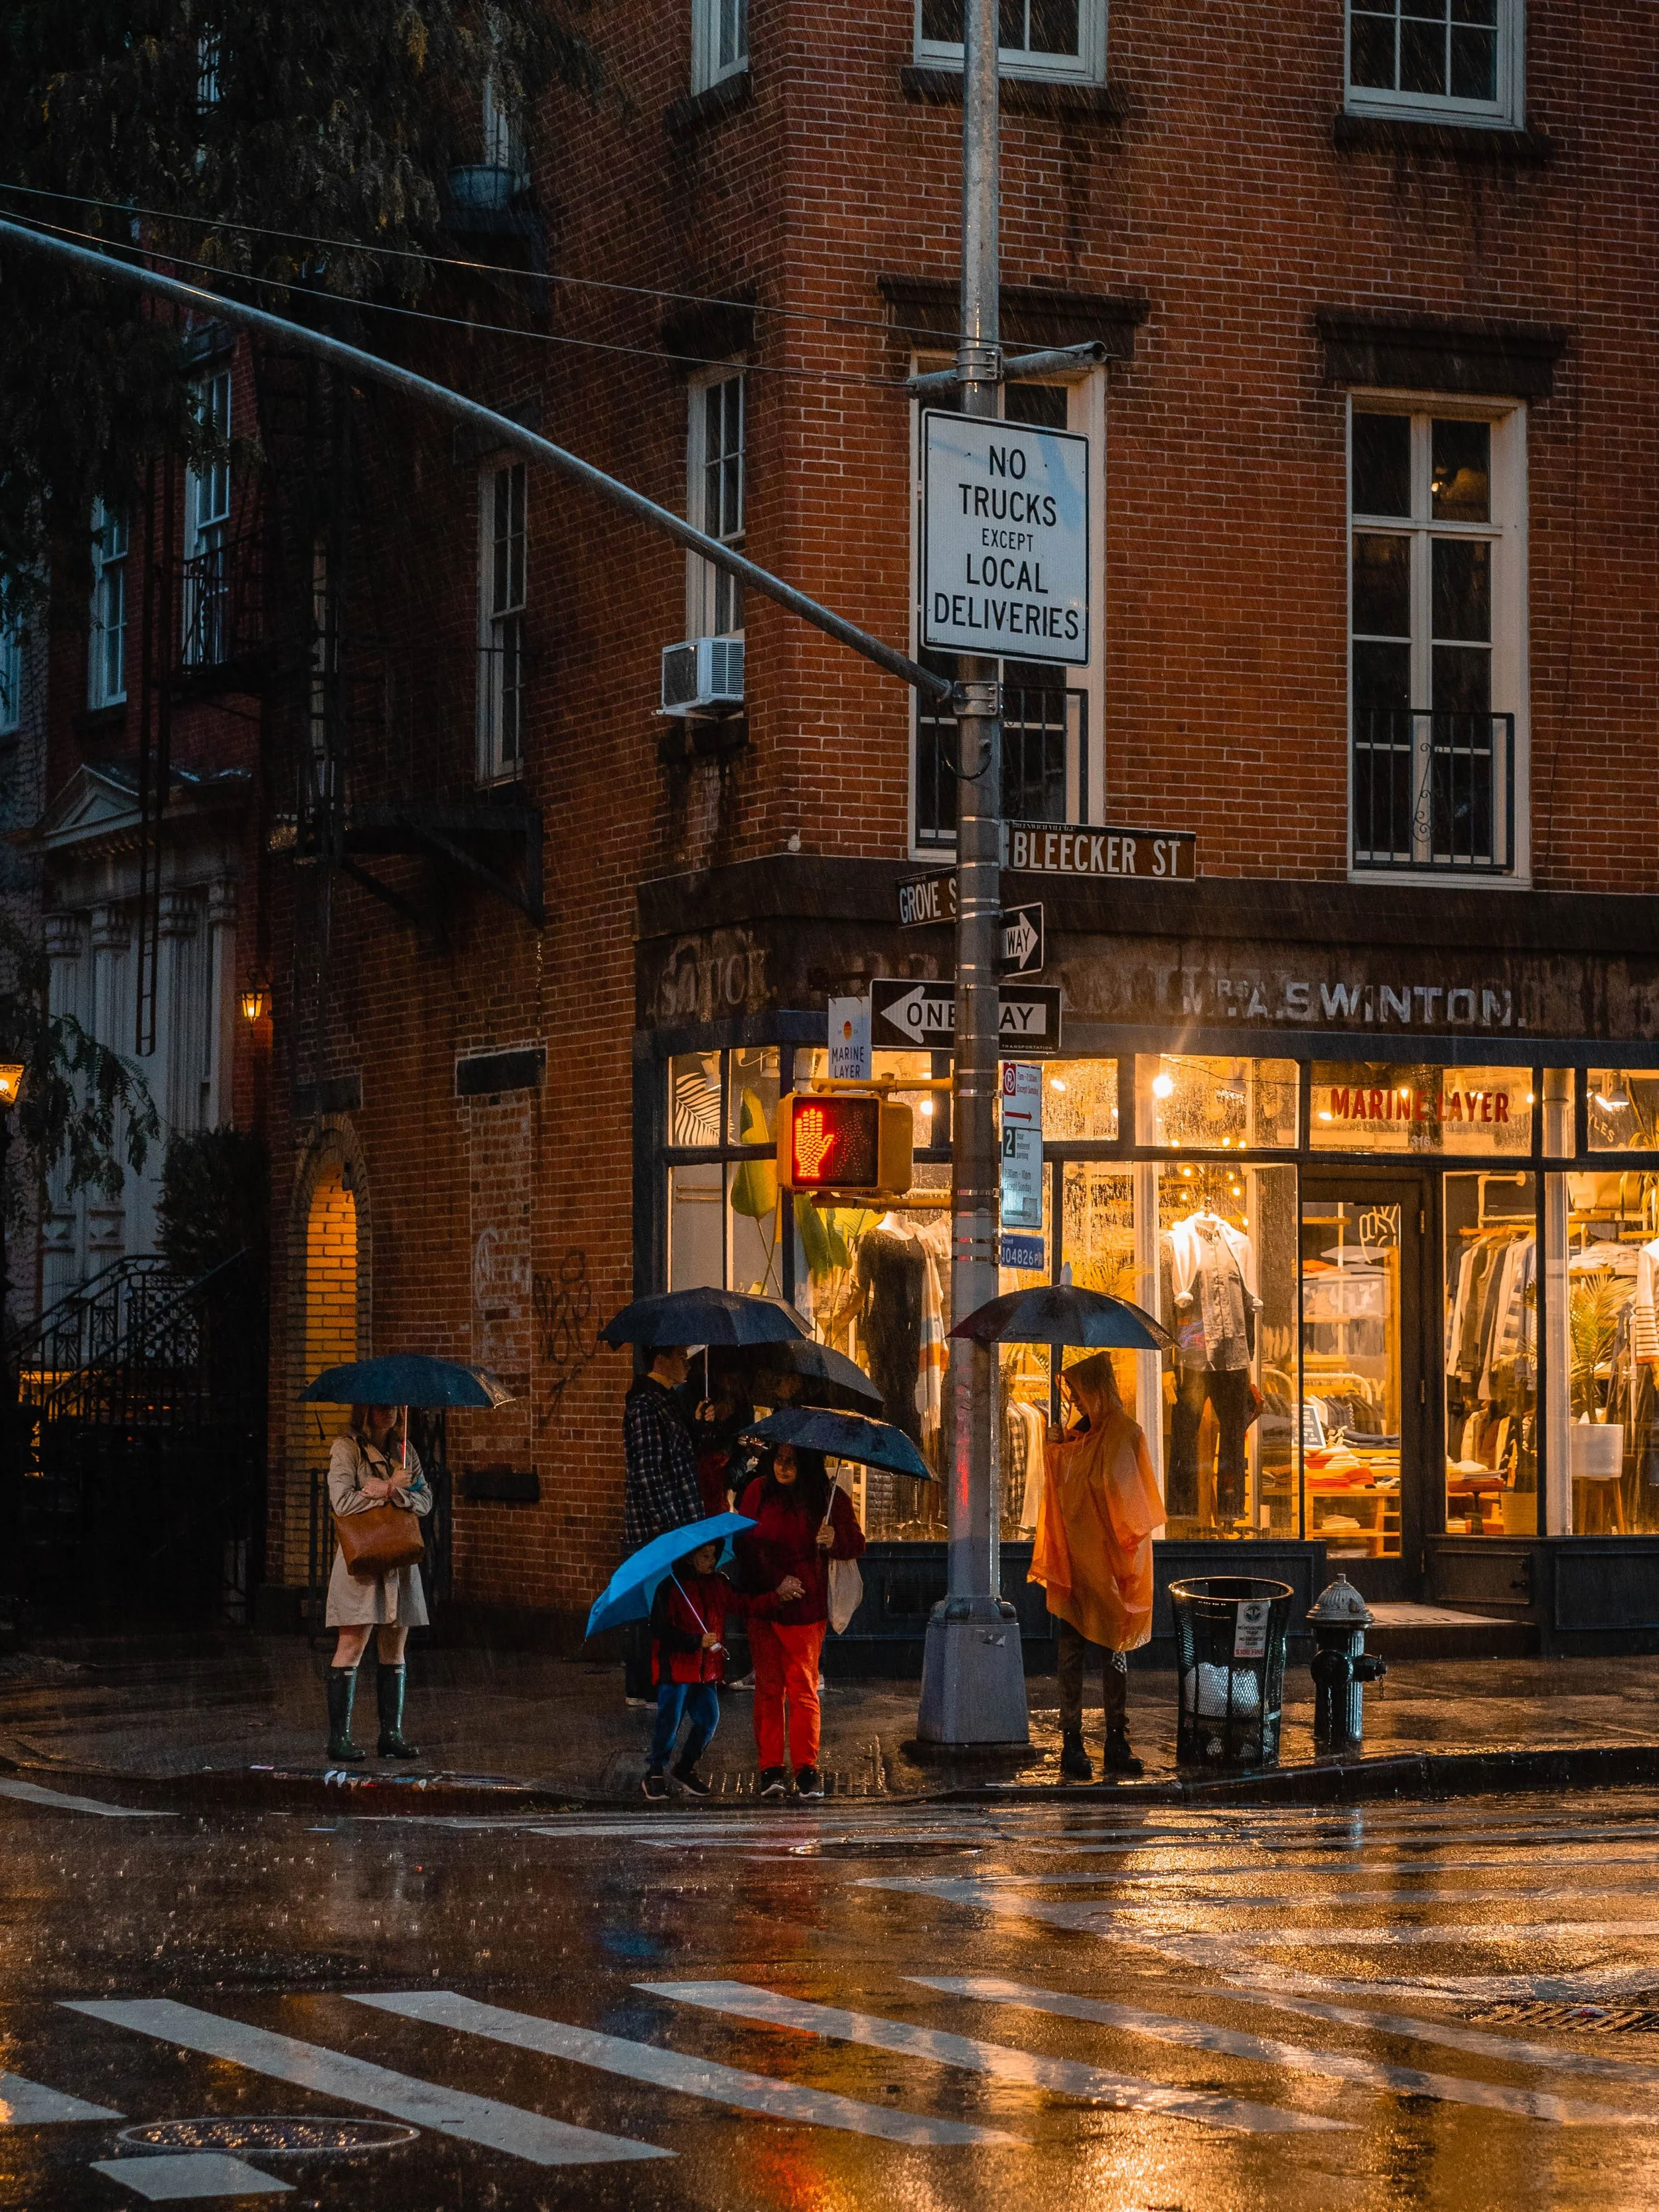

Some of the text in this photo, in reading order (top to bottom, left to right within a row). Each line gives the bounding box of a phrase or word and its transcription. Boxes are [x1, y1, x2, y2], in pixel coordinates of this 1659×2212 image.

[989, 445, 1026, 480] NO
[959, 484, 1056, 527] TRUCKS
[982, 528, 1034, 552] EXCEPT
[966, 553, 1048, 594] LOCAL
[934, 592, 1079, 640] DELIVERIES
[1013, 831, 1181, 876] BLEECKER ST
[900, 877, 956, 924] GROVE S
[1007, 928, 1030, 955] WAY
[999, 1006, 1034, 1030] AY
[832, 1047, 864, 1064] MARINE
[834, 1065, 860, 1079] LAYER
[1331, 1088, 1508, 1123] MARINE LAYER
[1006, 1129, 1013, 1154] 2
